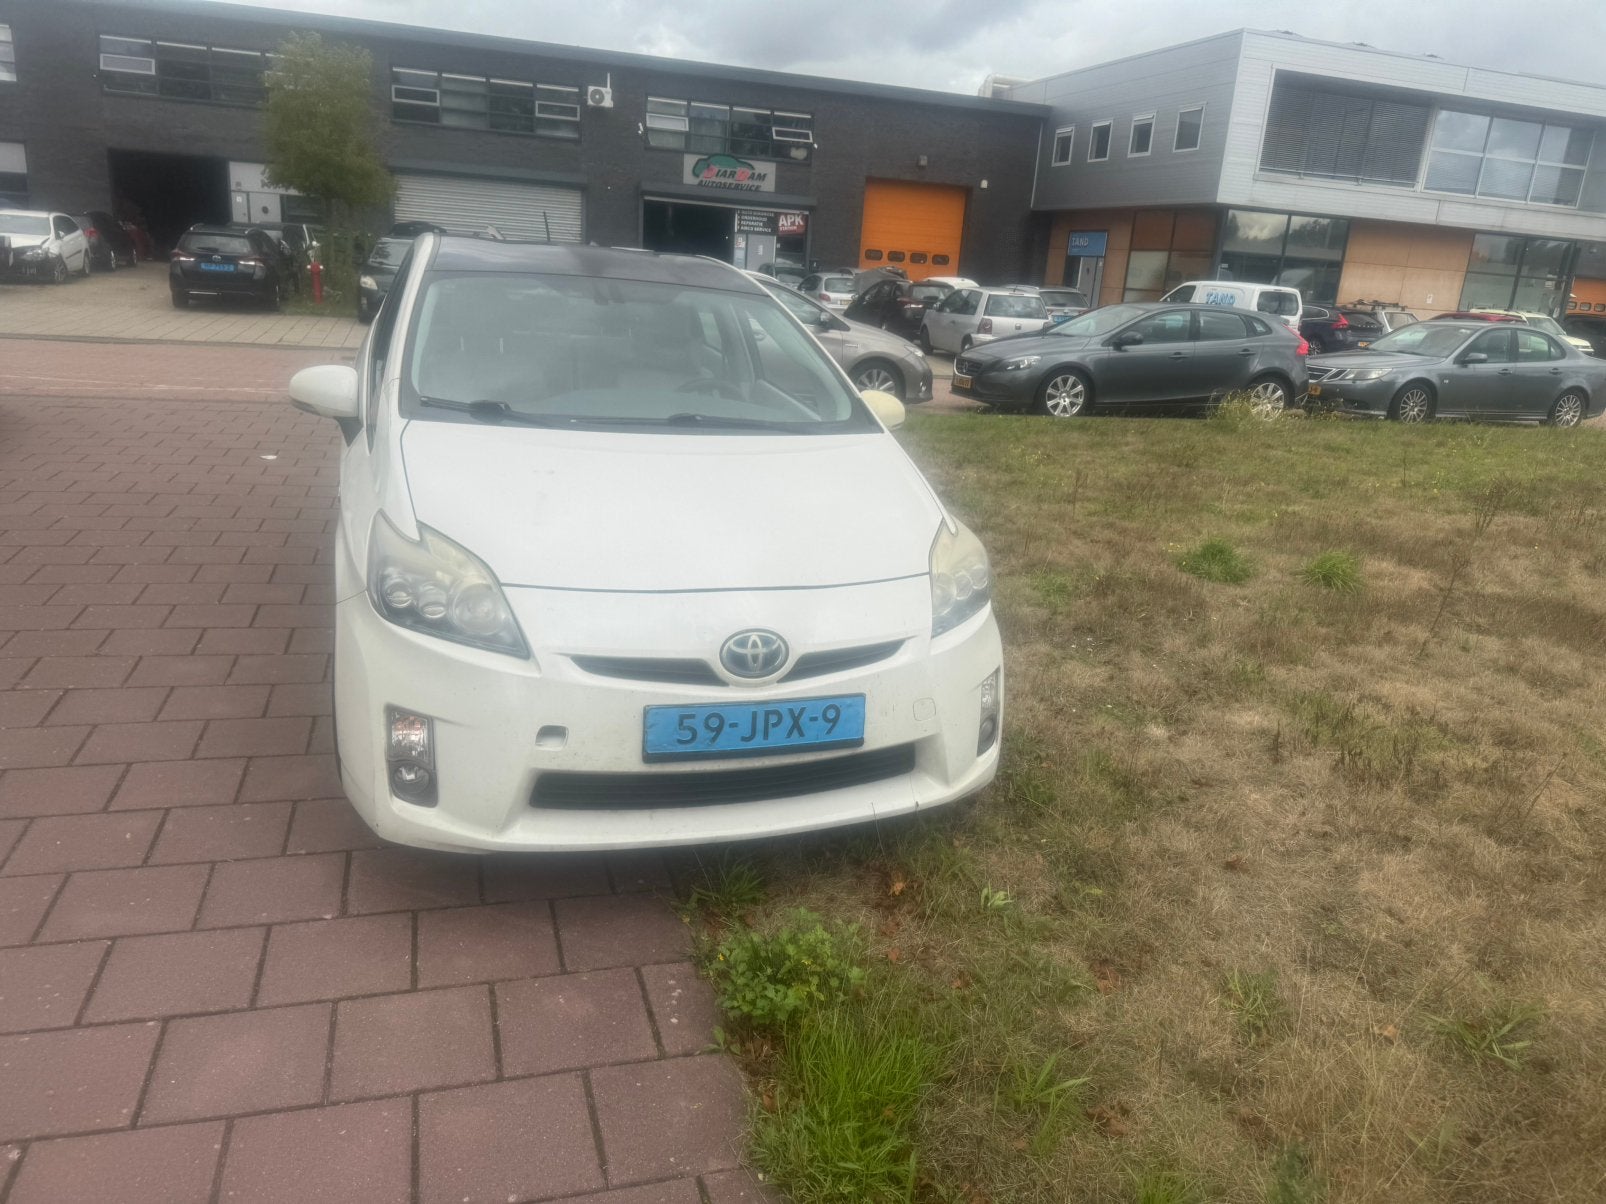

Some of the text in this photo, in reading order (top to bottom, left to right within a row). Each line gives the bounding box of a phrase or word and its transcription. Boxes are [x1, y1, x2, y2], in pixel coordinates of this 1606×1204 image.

[697, 179, 762, 192] AUTOSERVICE
[778, 214, 804, 227] APK
[676, 703, 841, 745] 59-JPX-9
